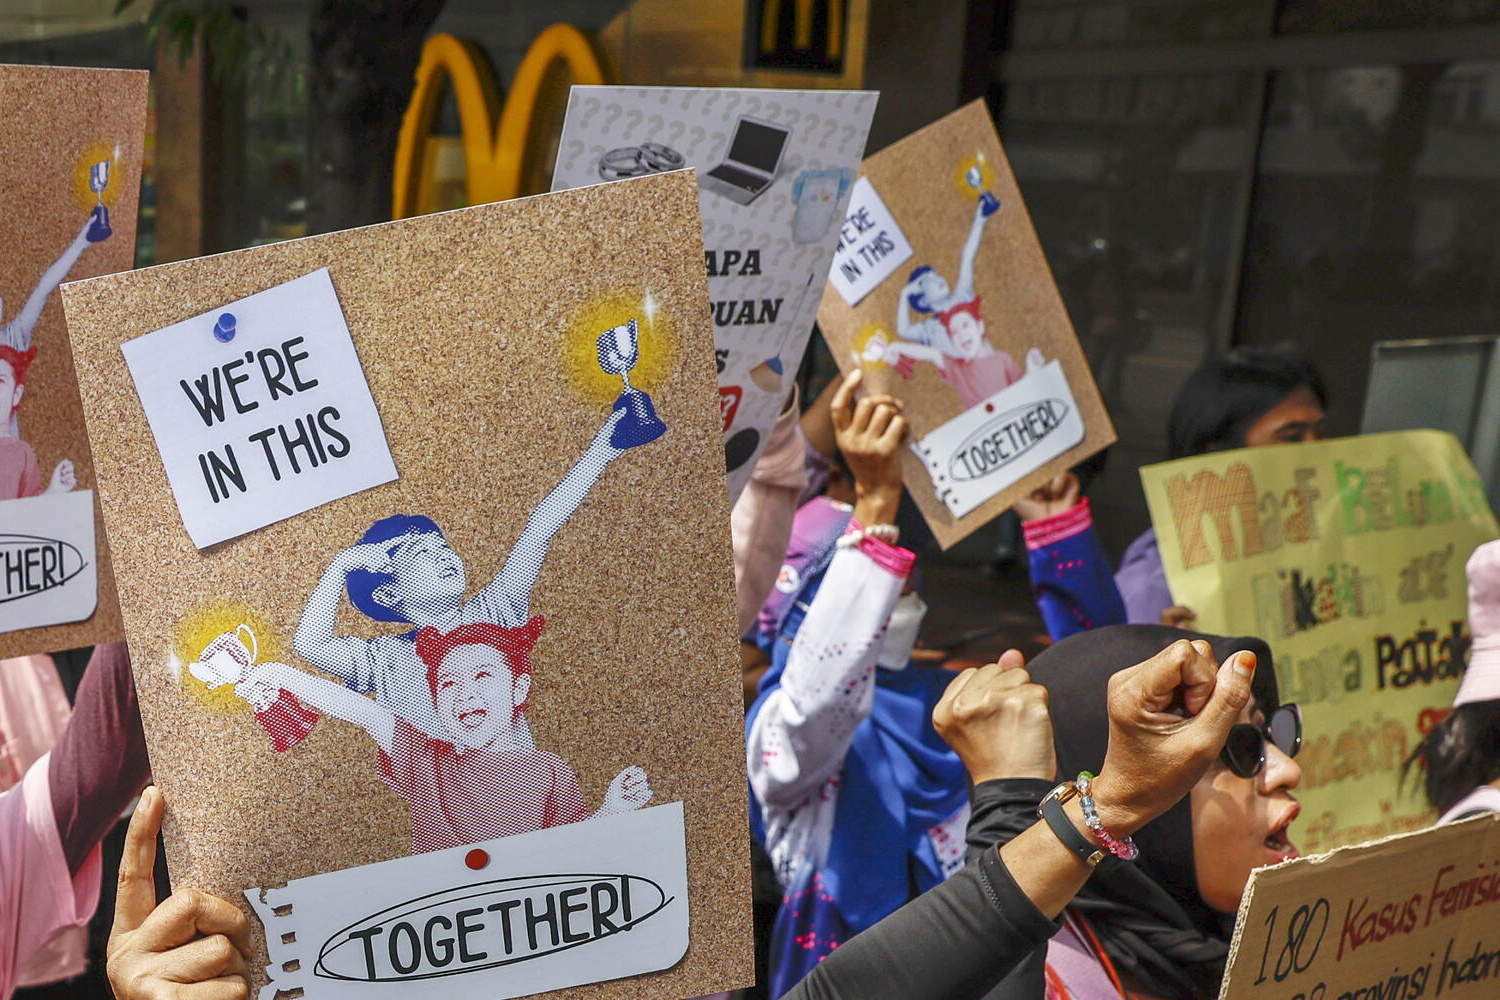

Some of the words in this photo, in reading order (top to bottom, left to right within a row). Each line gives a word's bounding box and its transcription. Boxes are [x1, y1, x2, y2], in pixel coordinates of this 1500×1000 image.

[704, 249, 762, 278] APA
[840, 257, 862, 285] IN
[857, 230, 895, 268] THIS
[179, 335, 319, 427] WE'RE
[198, 443, 247, 503] IN
[248, 405, 351, 482] THIS
[956, 399, 1059, 480] TOGETHER!
[349, 874, 634, 981] TOGETHER!
[1253, 897, 1330, 986] 180
[1336, 893, 1422, 962] Kasus
